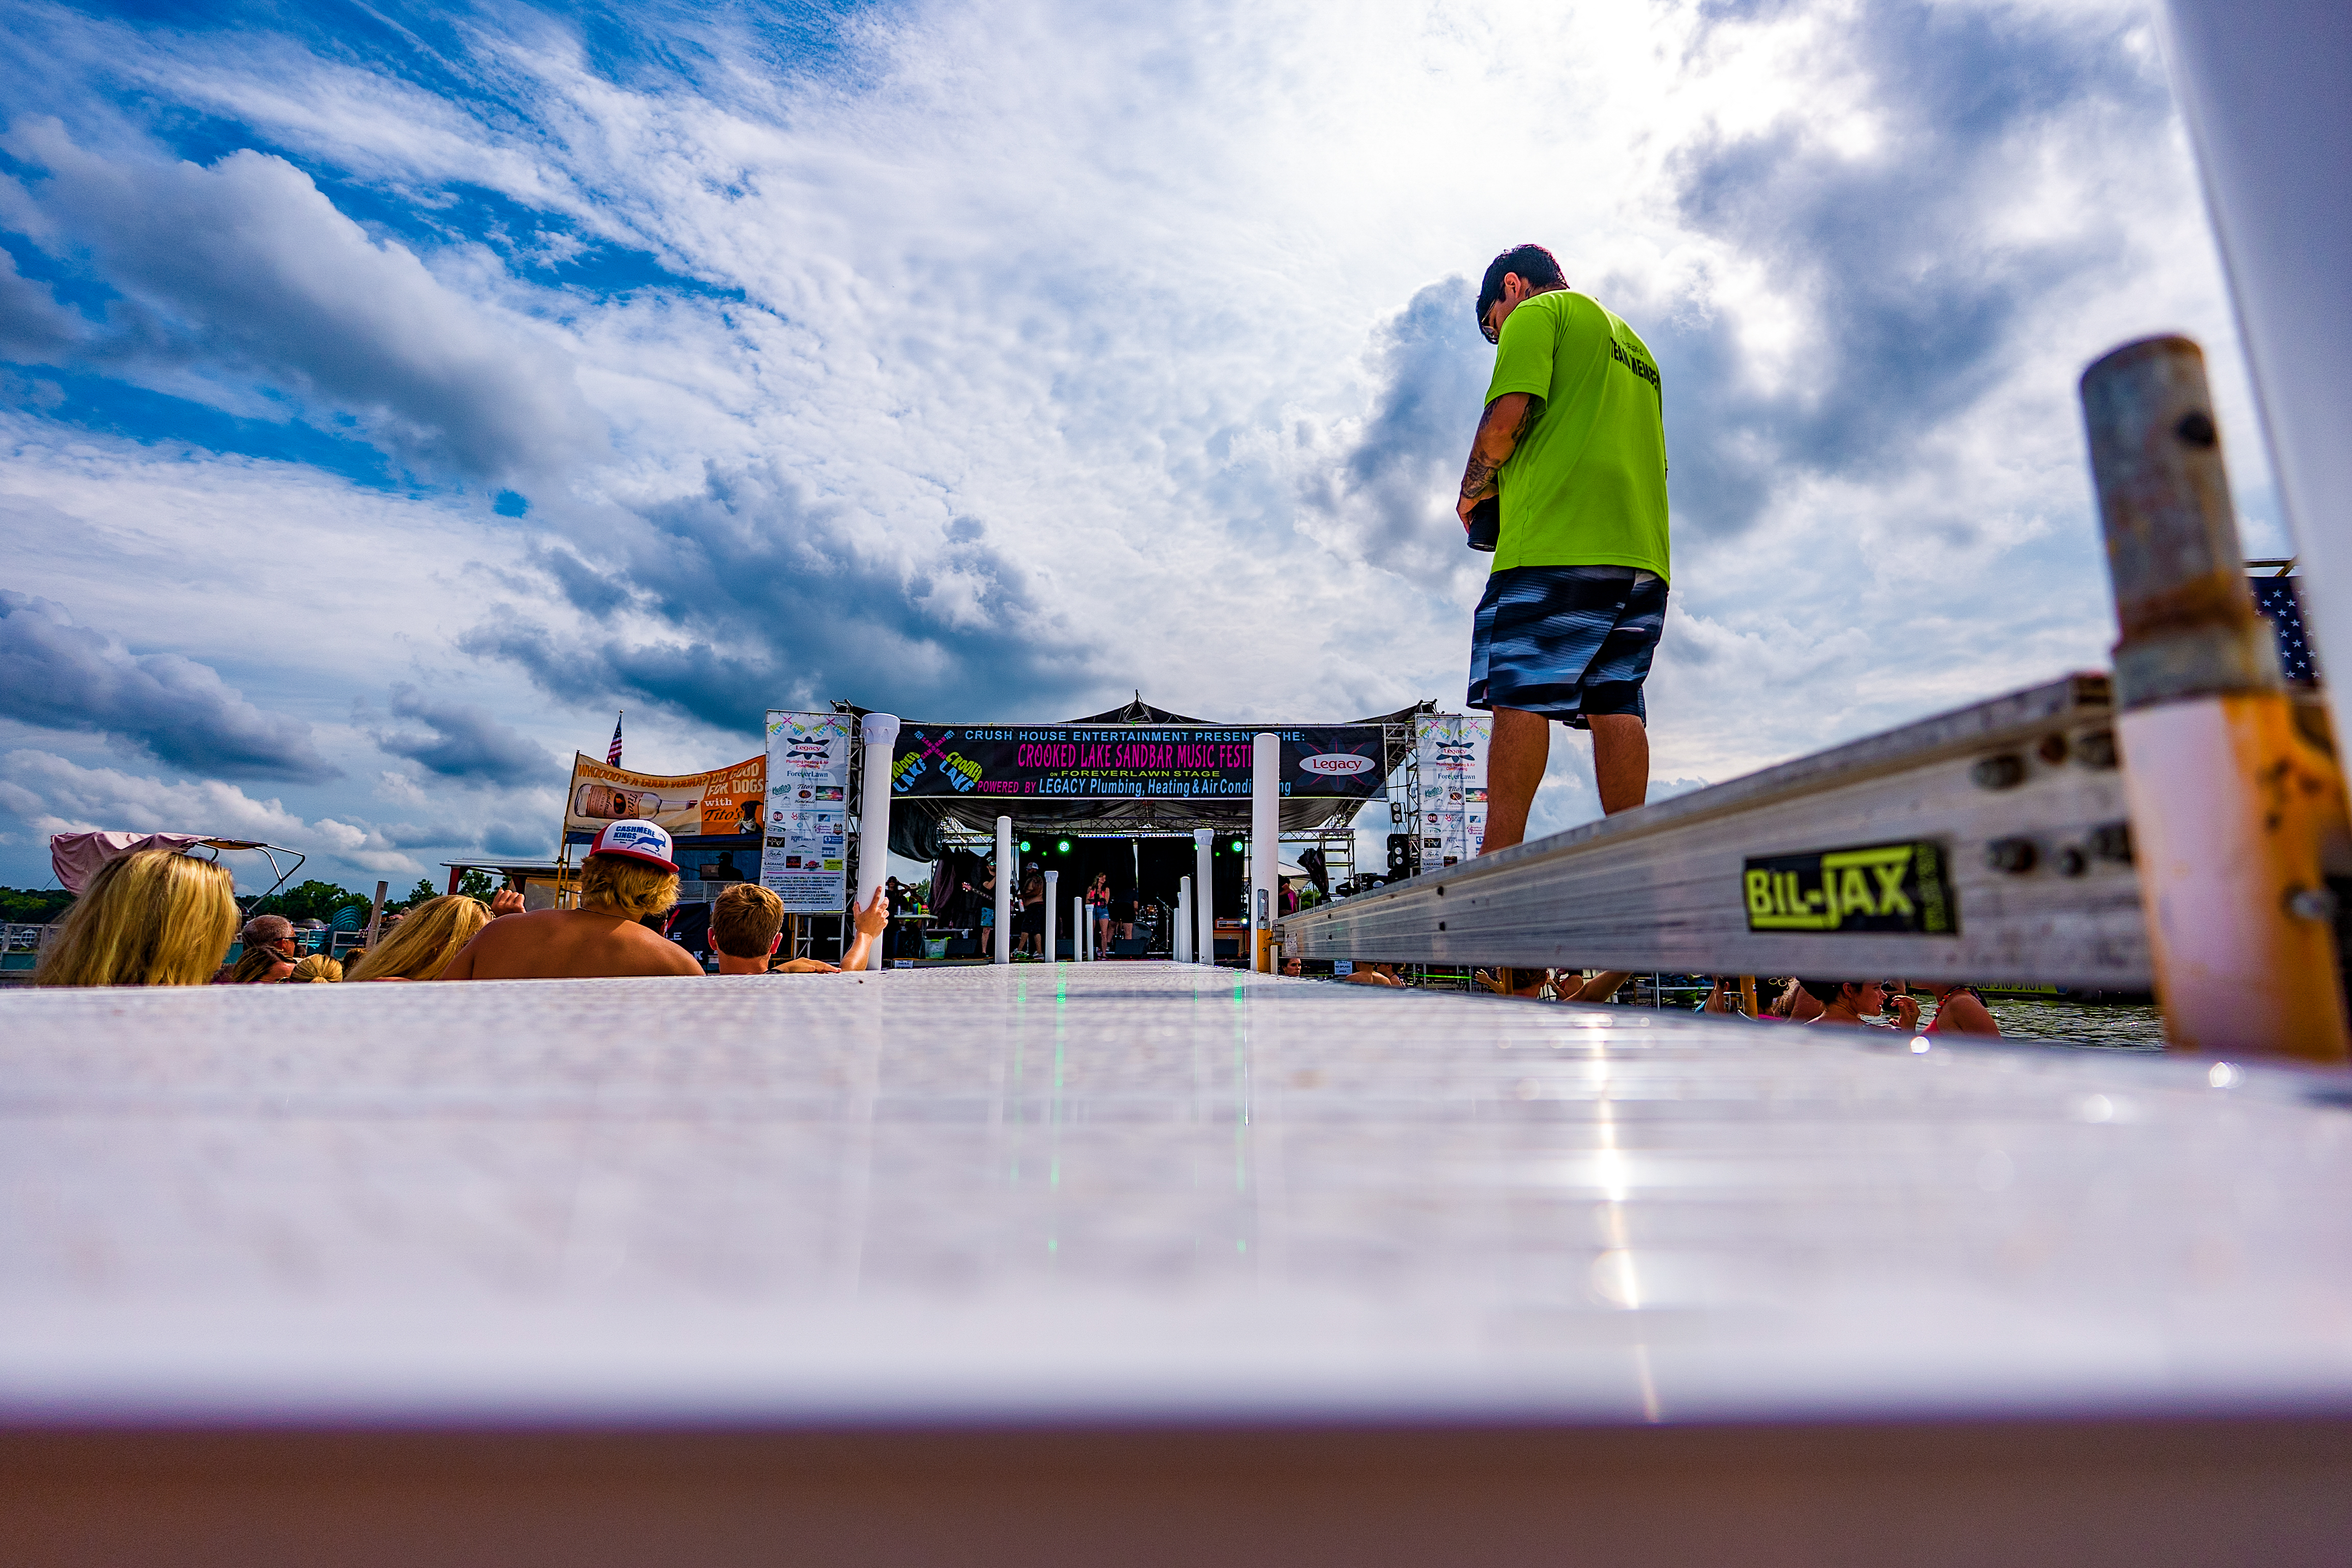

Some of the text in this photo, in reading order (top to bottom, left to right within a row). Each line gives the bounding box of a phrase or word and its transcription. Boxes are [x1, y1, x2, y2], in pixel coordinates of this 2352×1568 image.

[1610, 337, 1631, 370] TEAM
[965, 730, 1013, 740] CRUSH
[1019, 731, 1066, 741] HOUSE
[1073, 732, 1188, 741] ENTERTAINMENT
[1195, 732, 1261, 741] PRESENT
[1018, 744, 1254, 768] CROOKED LAKE SANDBAR MUSIC FESTI
[1313, 759, 1362, 771] Legacy
[711, 763, 760, 784] DO GOOD
[892, 752, 920, 782] ROOKED
[893, 758, 926, 792] LAKE
[939, 760, 975, 792] LAKE
[946, 752, 983, 783] CROOKED
[630, 778, 639, 786] A
[641, 778, 668, 788] GOOD
[707, 778, 764, 797] FOR DOGS
[977, 778, 1291, 797] POWERED BY LEGACY Plumbing, Heating & Air Conding
[628, 793, 638, 817] Tito's
[704, 798, 732, 806] with
[704, 807, 743, 821] Tito's
[616, 826, 655, 838] CASHMERE
[1745, 846, 1916, 928] BIL-JAX
